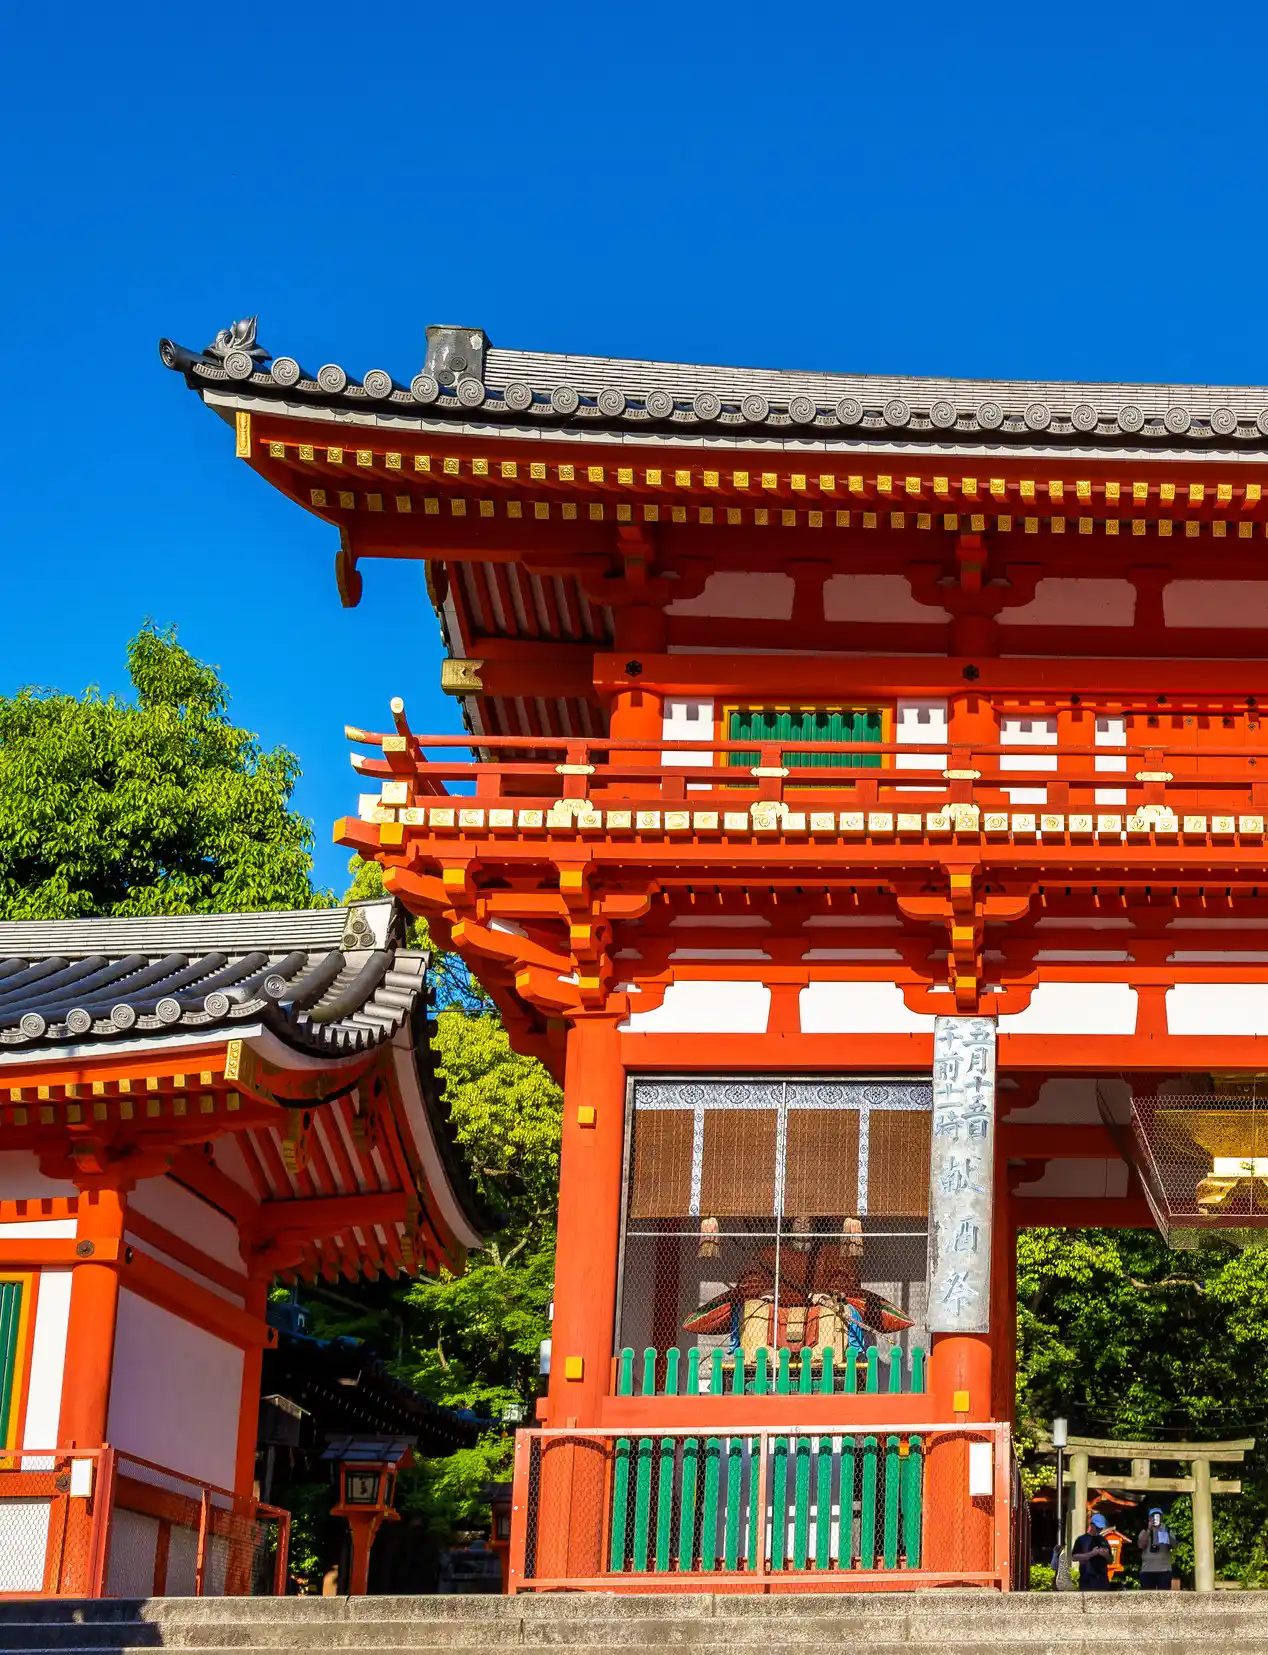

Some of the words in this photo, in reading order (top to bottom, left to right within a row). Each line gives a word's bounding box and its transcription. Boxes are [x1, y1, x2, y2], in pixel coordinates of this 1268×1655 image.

[961, 1020, 994, 1140] 五月十五日
